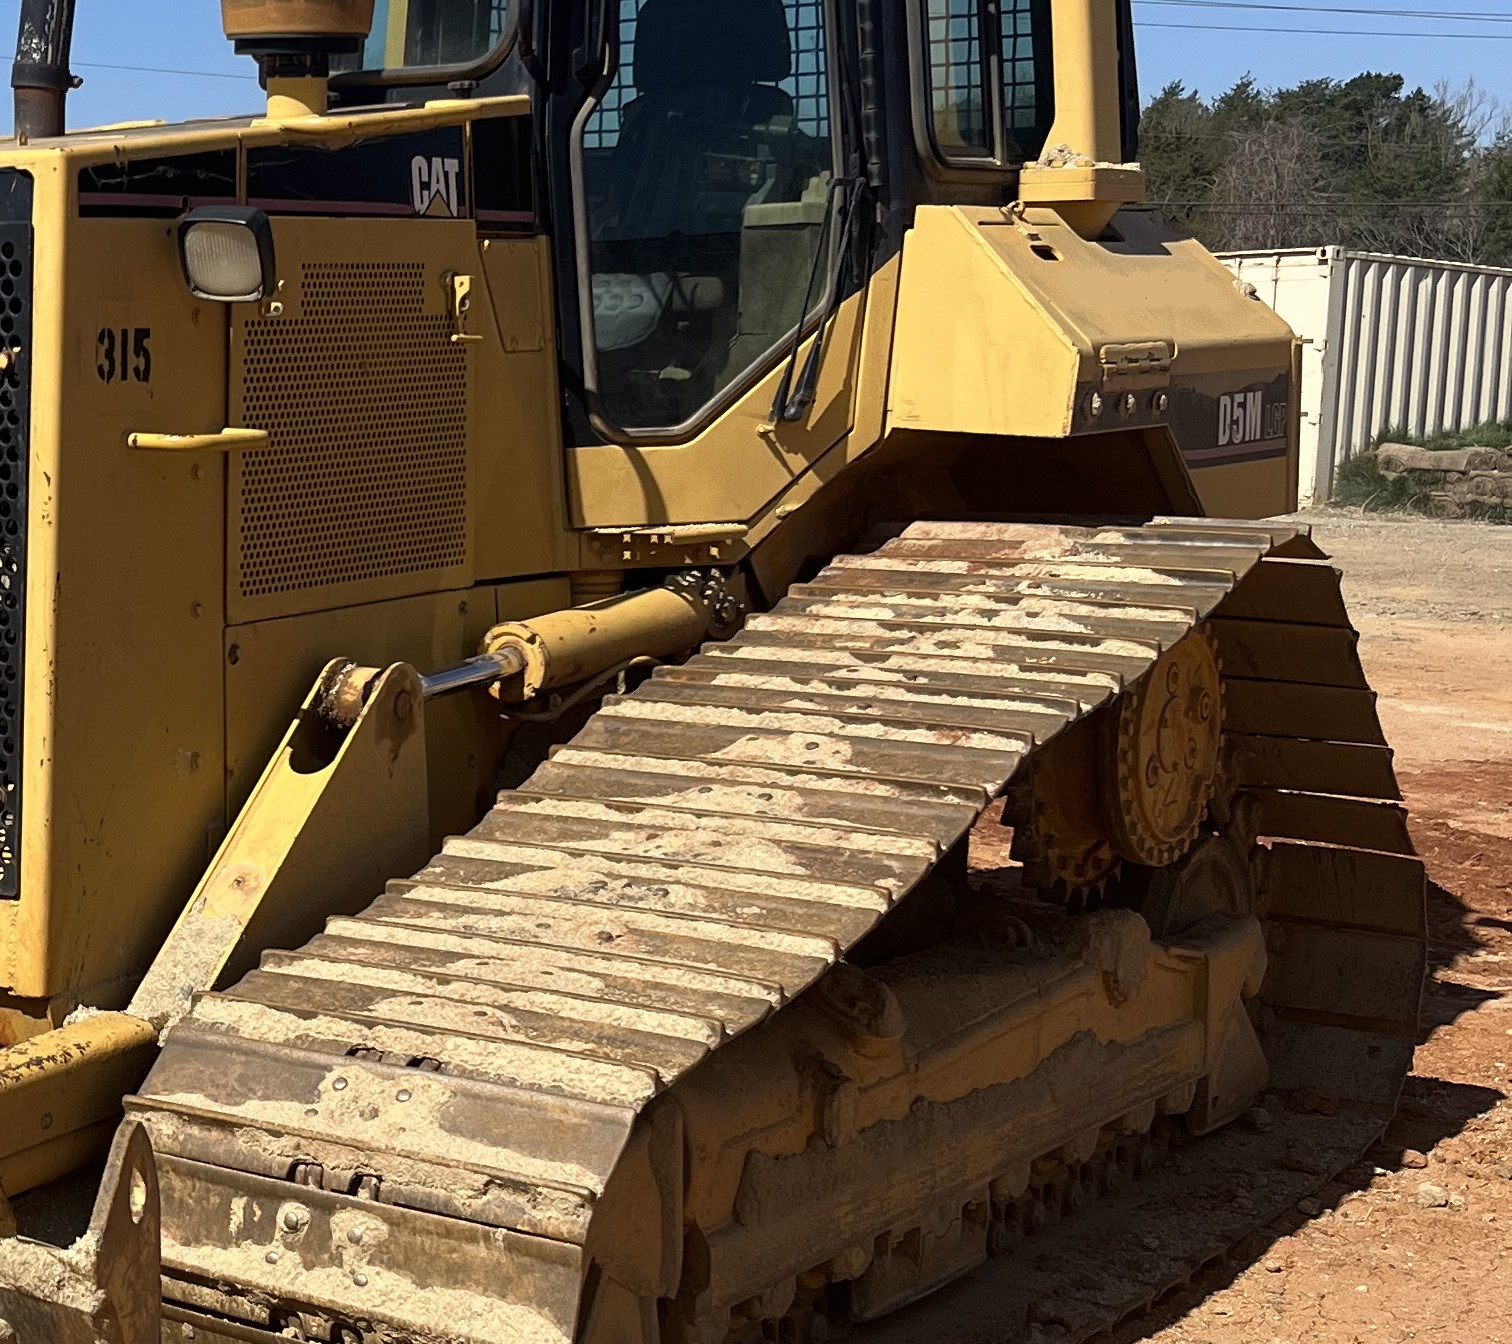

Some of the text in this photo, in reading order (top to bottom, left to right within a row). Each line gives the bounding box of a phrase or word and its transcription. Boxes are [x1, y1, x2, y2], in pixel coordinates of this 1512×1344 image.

[411, 155, 459, 218] CAT
[97, 327, 151, 384] 315
[1217, 390, 1262, 446] D5M
